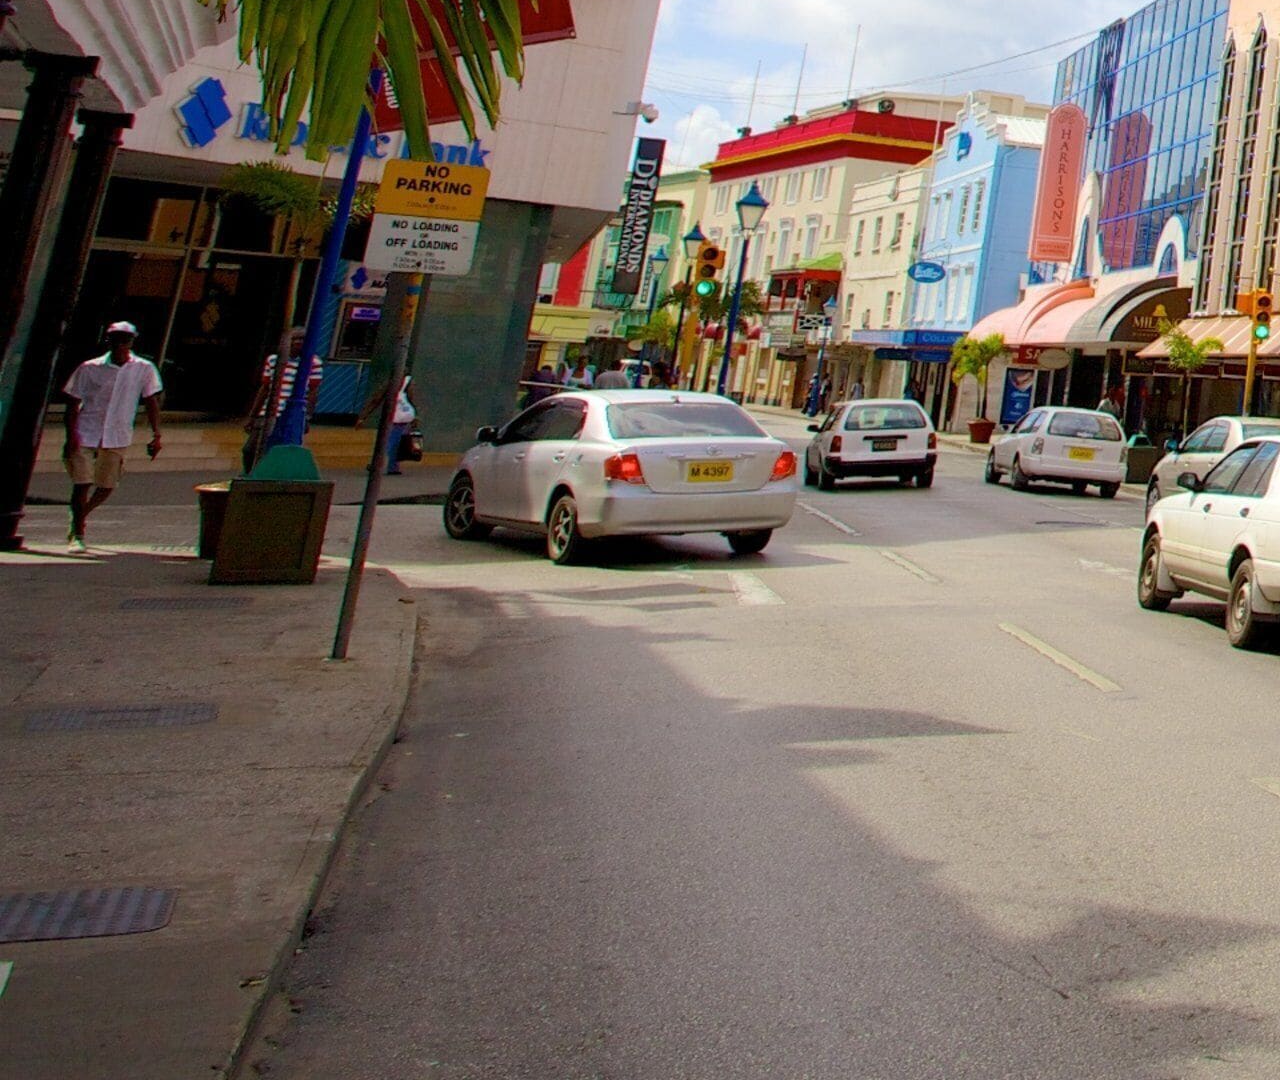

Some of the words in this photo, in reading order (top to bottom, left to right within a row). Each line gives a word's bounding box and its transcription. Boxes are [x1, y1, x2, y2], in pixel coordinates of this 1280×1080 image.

[425, 165, 450, 179] NO
[395, 178, 472, 196] PARKING
[1052, 128, 1072, 233] HARRISONS
[392, 220, 408, 229] NO
[412, 221, 459, 233] LOADING
[616, 187, 640, 271] INTERNATIONAL
[626, 189, 654, 273] DIAMONDS
[385, 238, 408, 247] OFF
[411, 239, 458, 251] LOADING
[691, 467, 701, 477] M
[702, 466, 731, 477] 4397
